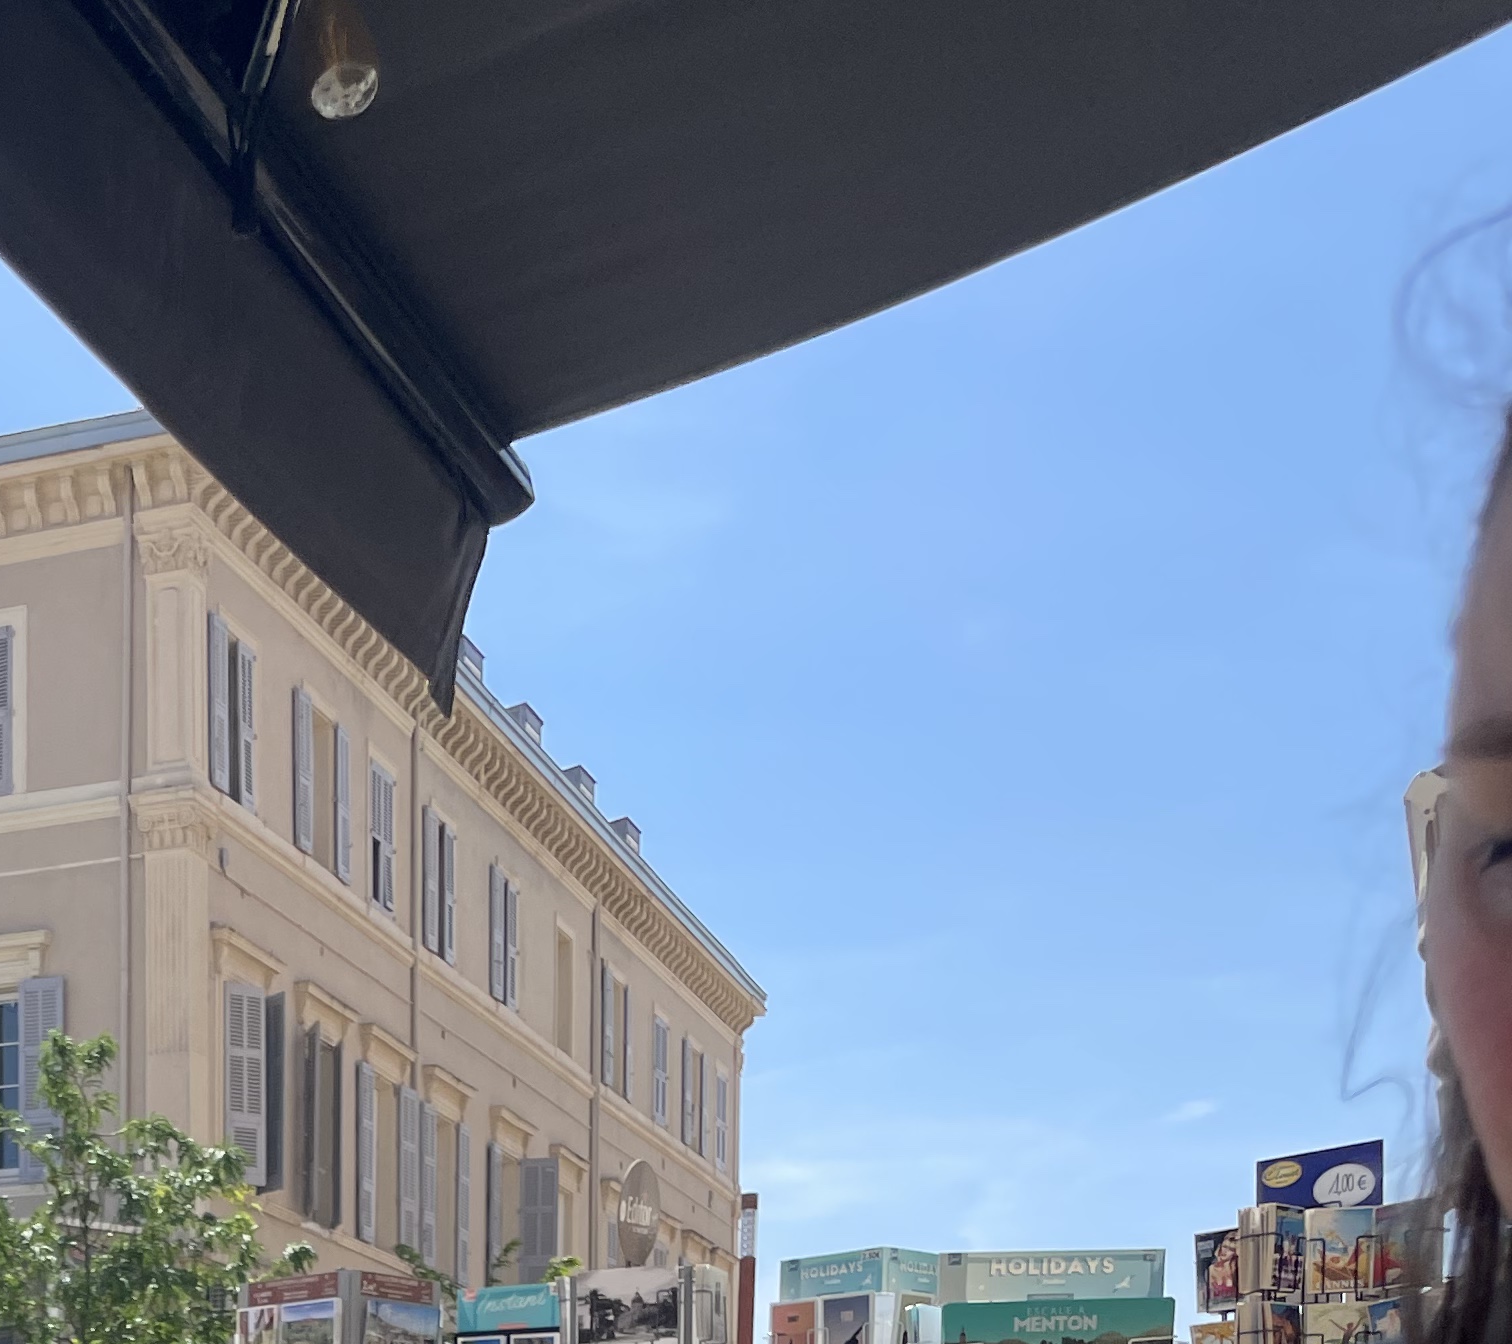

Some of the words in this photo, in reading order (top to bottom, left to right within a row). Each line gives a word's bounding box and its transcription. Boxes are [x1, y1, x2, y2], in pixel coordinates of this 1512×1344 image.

[1357, 1174, 1368, 1191] €
[800, 1261, 864, 1281] HOLIDAYS
[990, 1256, 1115, 1277] HOLIDAYS
[1013, 1314, 1098, 1333] MENTON
